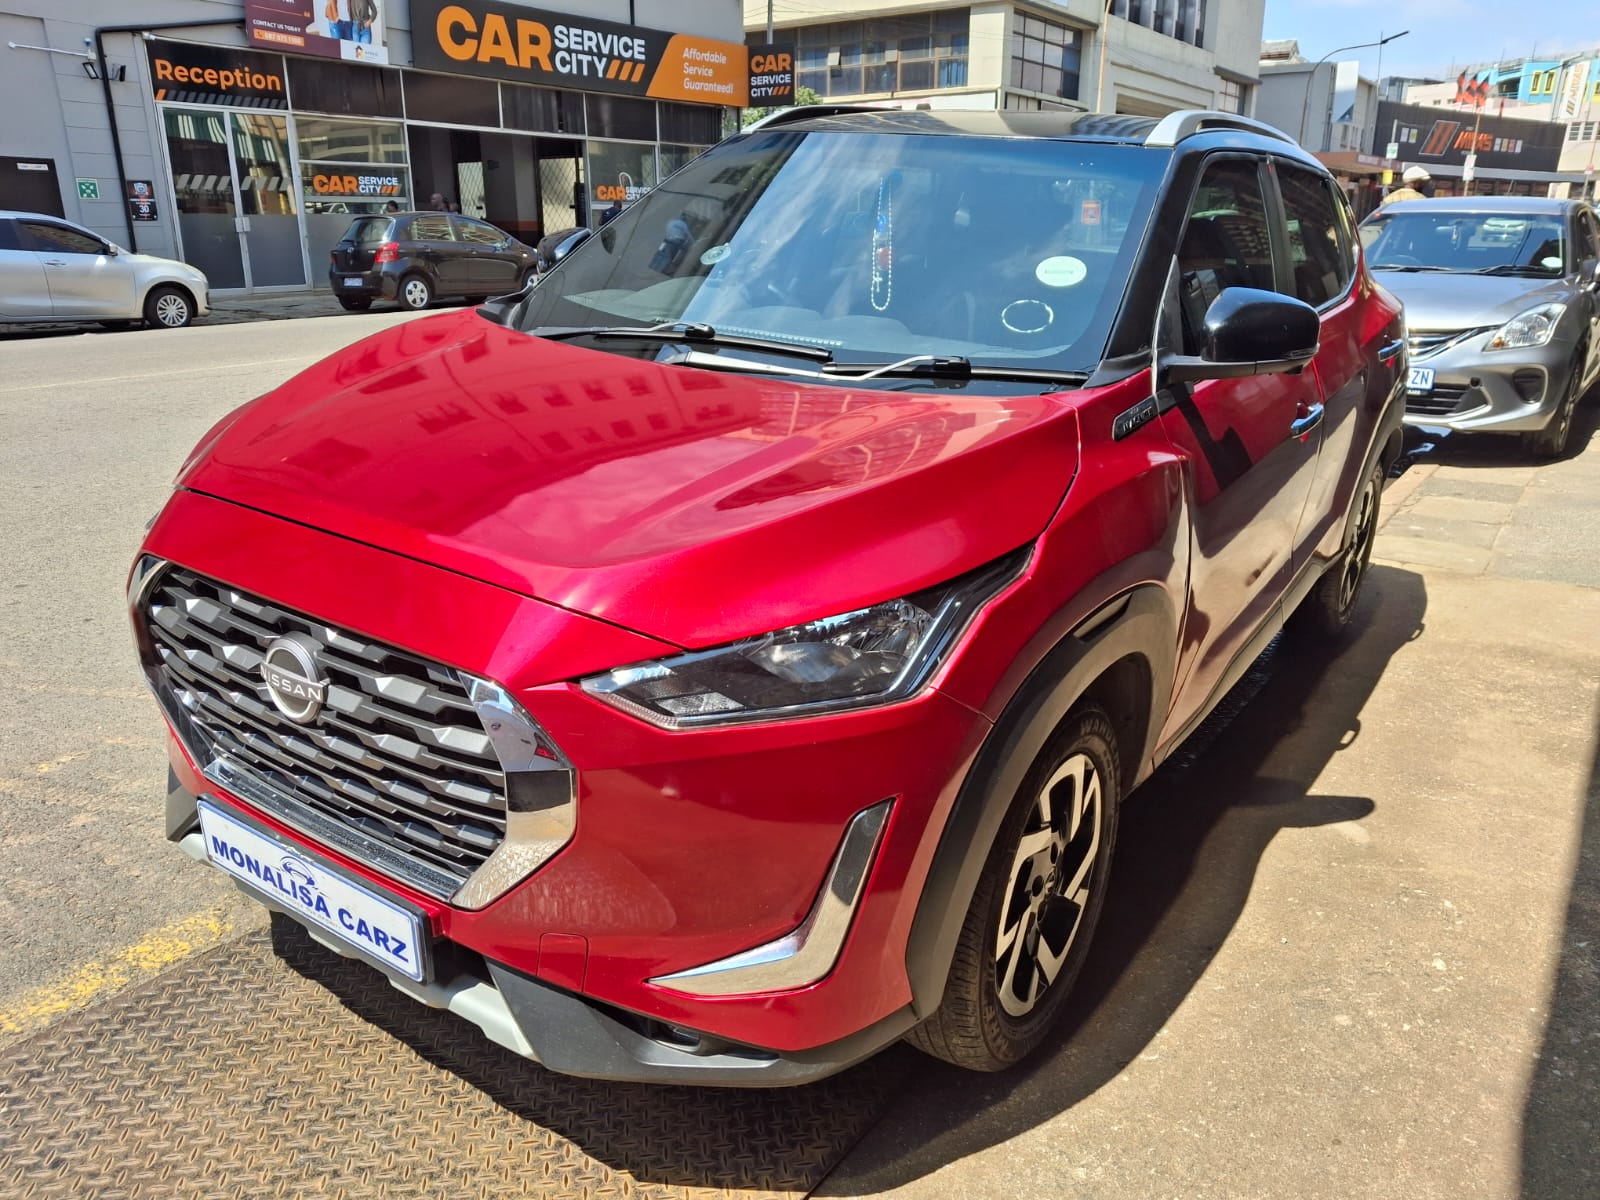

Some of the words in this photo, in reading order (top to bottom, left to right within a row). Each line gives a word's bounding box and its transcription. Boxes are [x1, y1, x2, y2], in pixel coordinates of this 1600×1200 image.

[435, 5, 553, 72] CAR
[553, 24, 646, 61] SERVICE
[553, 50, 608, 79] CITY
[683, 47, 727, 65] Affordable
[750, 53, 791, 73] CAR
[154, 58, 282, 92] Reception
[683, 63, 714, 78] Service
[683, 77, 734, 95] Guaranteed!
[750, 74, 792, 86] SERVICE
[750, 86, 774, 97] CITY
[312, 174, 358, 194] CAR
[358, 175, 399, 185] SERVICE
[358, 184, 381, 194] CITY
[597, 185, 626, 200] CAR
[138, 205, 150, 214] 30
[1411, 370, 1430, 385] ZN
[260, 663, 321, 701] NISSAN
[211, 834, 331, 920] MONALISA
[337, 907, 409, 963] CARZ
